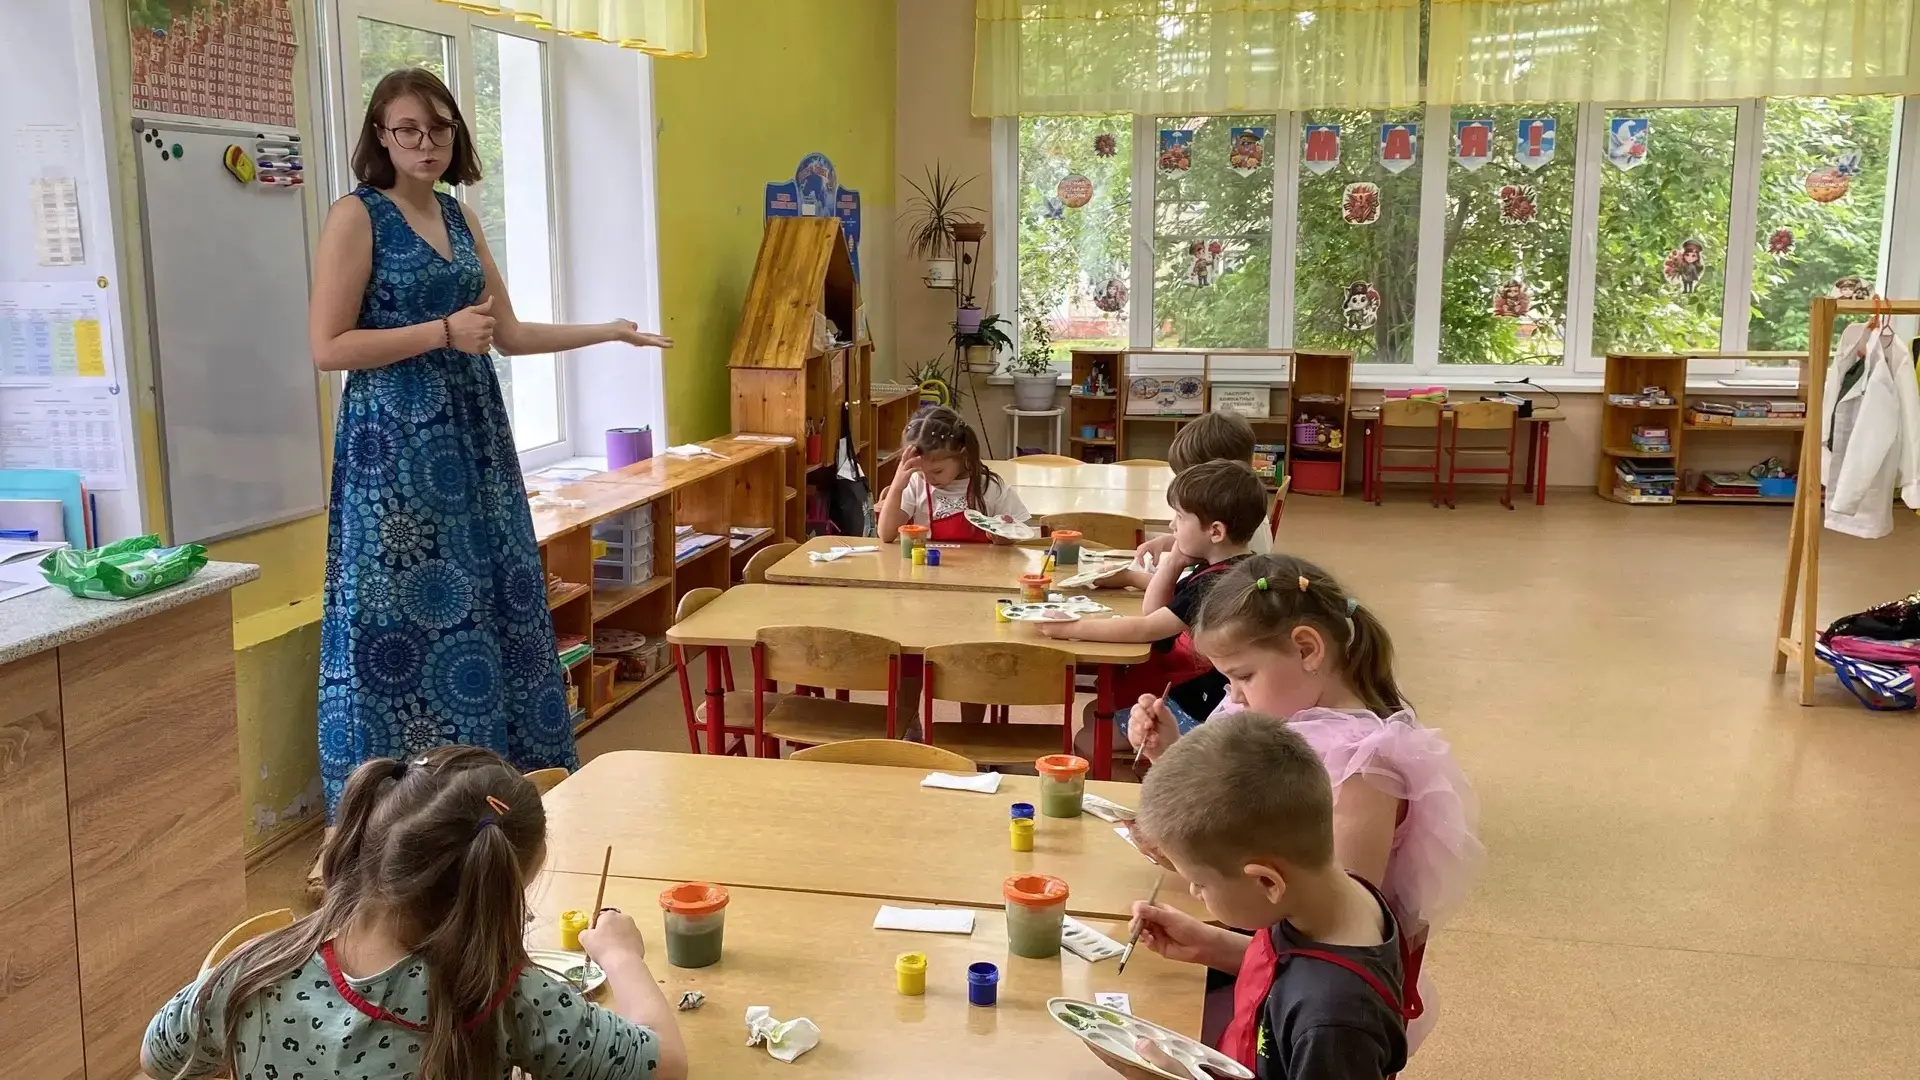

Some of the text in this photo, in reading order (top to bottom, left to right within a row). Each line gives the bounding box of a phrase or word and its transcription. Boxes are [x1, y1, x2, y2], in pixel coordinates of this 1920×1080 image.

[210, 44, 224, 55] 15
[190, 54, 205, 65] 14
[210, 56, 224, 67] 24
[151, 74, 166, 85] 12
[171, 78, 186, 88] 22
[133, 84, 148, 96] 11
[153, 87, 167, 98] 21
